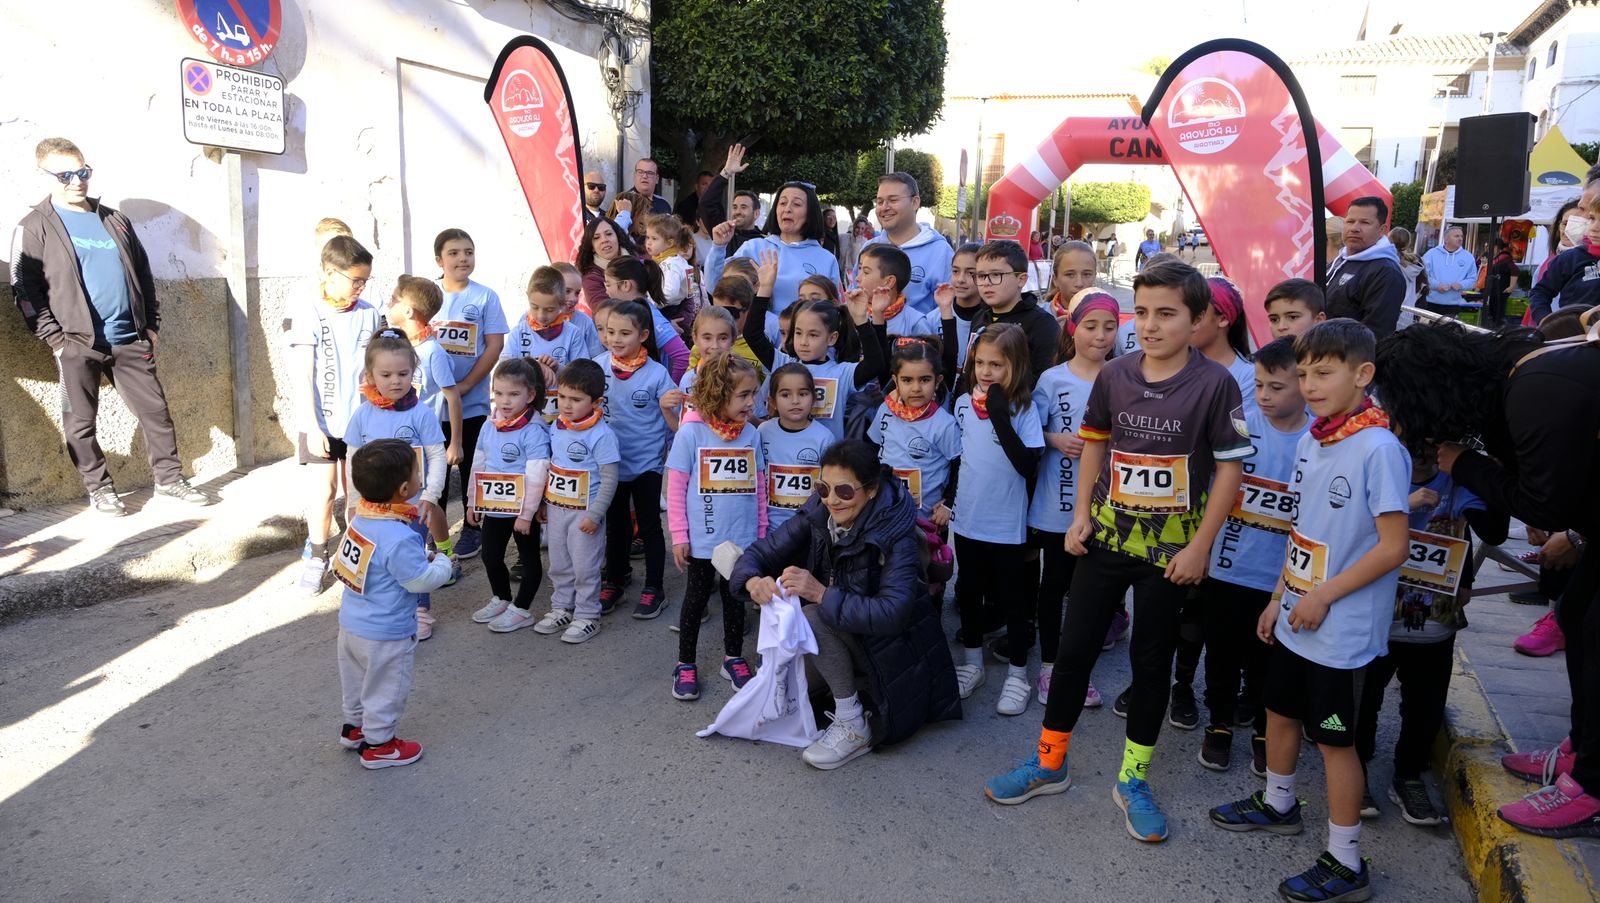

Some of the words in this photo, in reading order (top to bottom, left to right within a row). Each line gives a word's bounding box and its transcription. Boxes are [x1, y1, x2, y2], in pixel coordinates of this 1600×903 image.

[192, 24, 208, 43] de
[210, 40, 220, 52] 7
[221, 47, 234, 62] h.
[236, 54, 245, 64] a
[246, 47, 261, 62] 15
[260, 43, 272, 55] h.
[216, 69, 281, 91] PROHIBIDO
[231, 85, 260, 97] PARAR
[222, 92, 277, 108] ESTACIONAR
[185, 98, 199, 109] EN
[203, 101, 232, 114] TODA
[235, 107, 248, 117] LA
[251, 109, 282, 123] PLAZA
[188, 120, 208, 129] hasta
[218, 124, 238, 134] Lunes
[206, 116, 232, 126] Viernes
[240, 121, 249, 129] las
[1107, 118, 1149, 130] AYU
[439, 328, 469, 341] 704
[1058, 392, 1071, 411] LA
[1117, 411, 1182, 432] CUELLAR
[1124, 430, 1150, 440] STONE
[710, 459, 748, 473] 748
[549, 473, 577, 492] 721
[775, 475, 811, 490] 749
[1120, 467, 1172, 488] 710
[483, 482, 516, 496] 732
[1246, 487, 1294, 513] 728
[342, 541, 361, 565] 03
[1290, 548, 1311, 571] 47
[1409, 543, 1447, 567] 34
[1320, 722, 1346, 731] adidas
